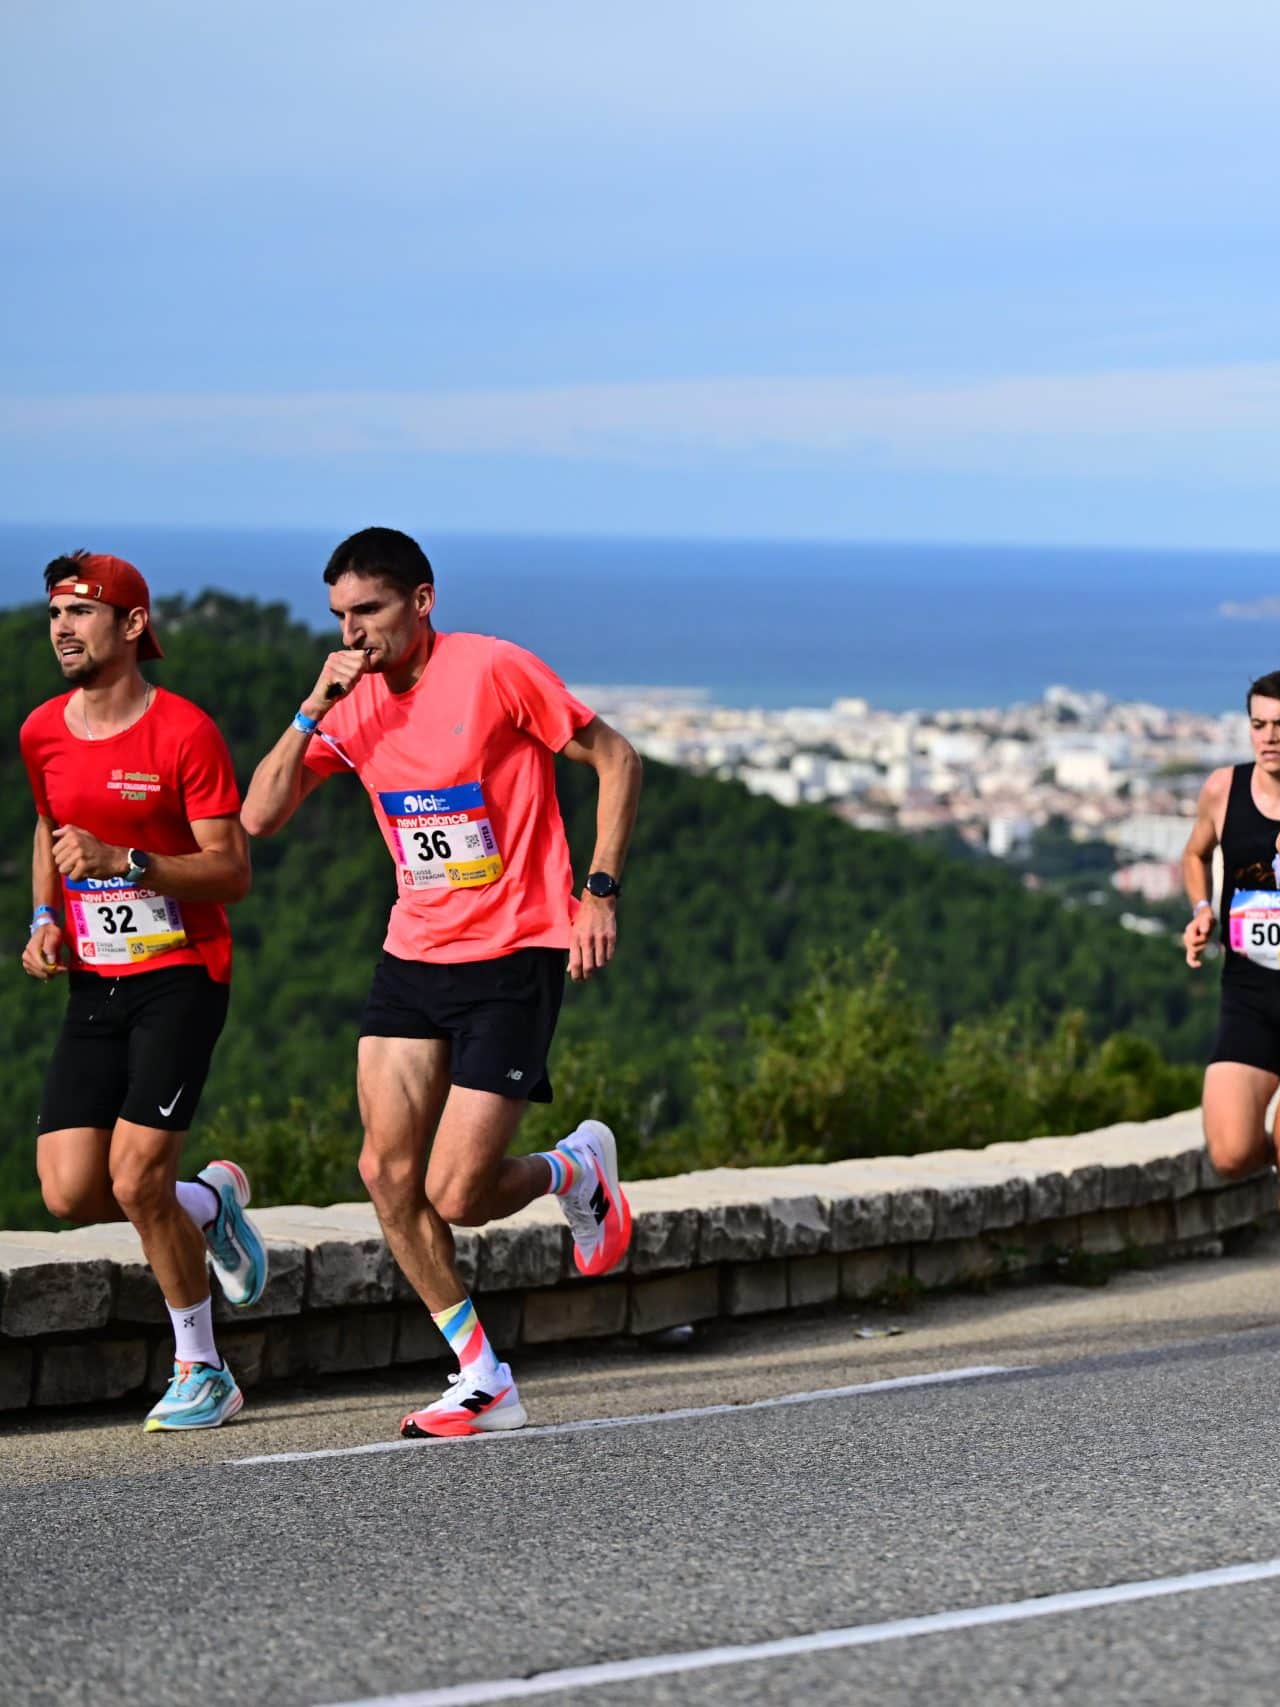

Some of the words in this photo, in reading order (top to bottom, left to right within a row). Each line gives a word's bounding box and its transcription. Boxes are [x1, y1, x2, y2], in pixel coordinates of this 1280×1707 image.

[417, 794, 438, 812] ici
[397, 818, 418, 828] new
[418, 813, 468, 827] balance
[413, 830, 451, 861] 36
[80, 892, 102, 903] new
[102, 889, 156, 902] balance
[97, 905, 138, 935] 32
